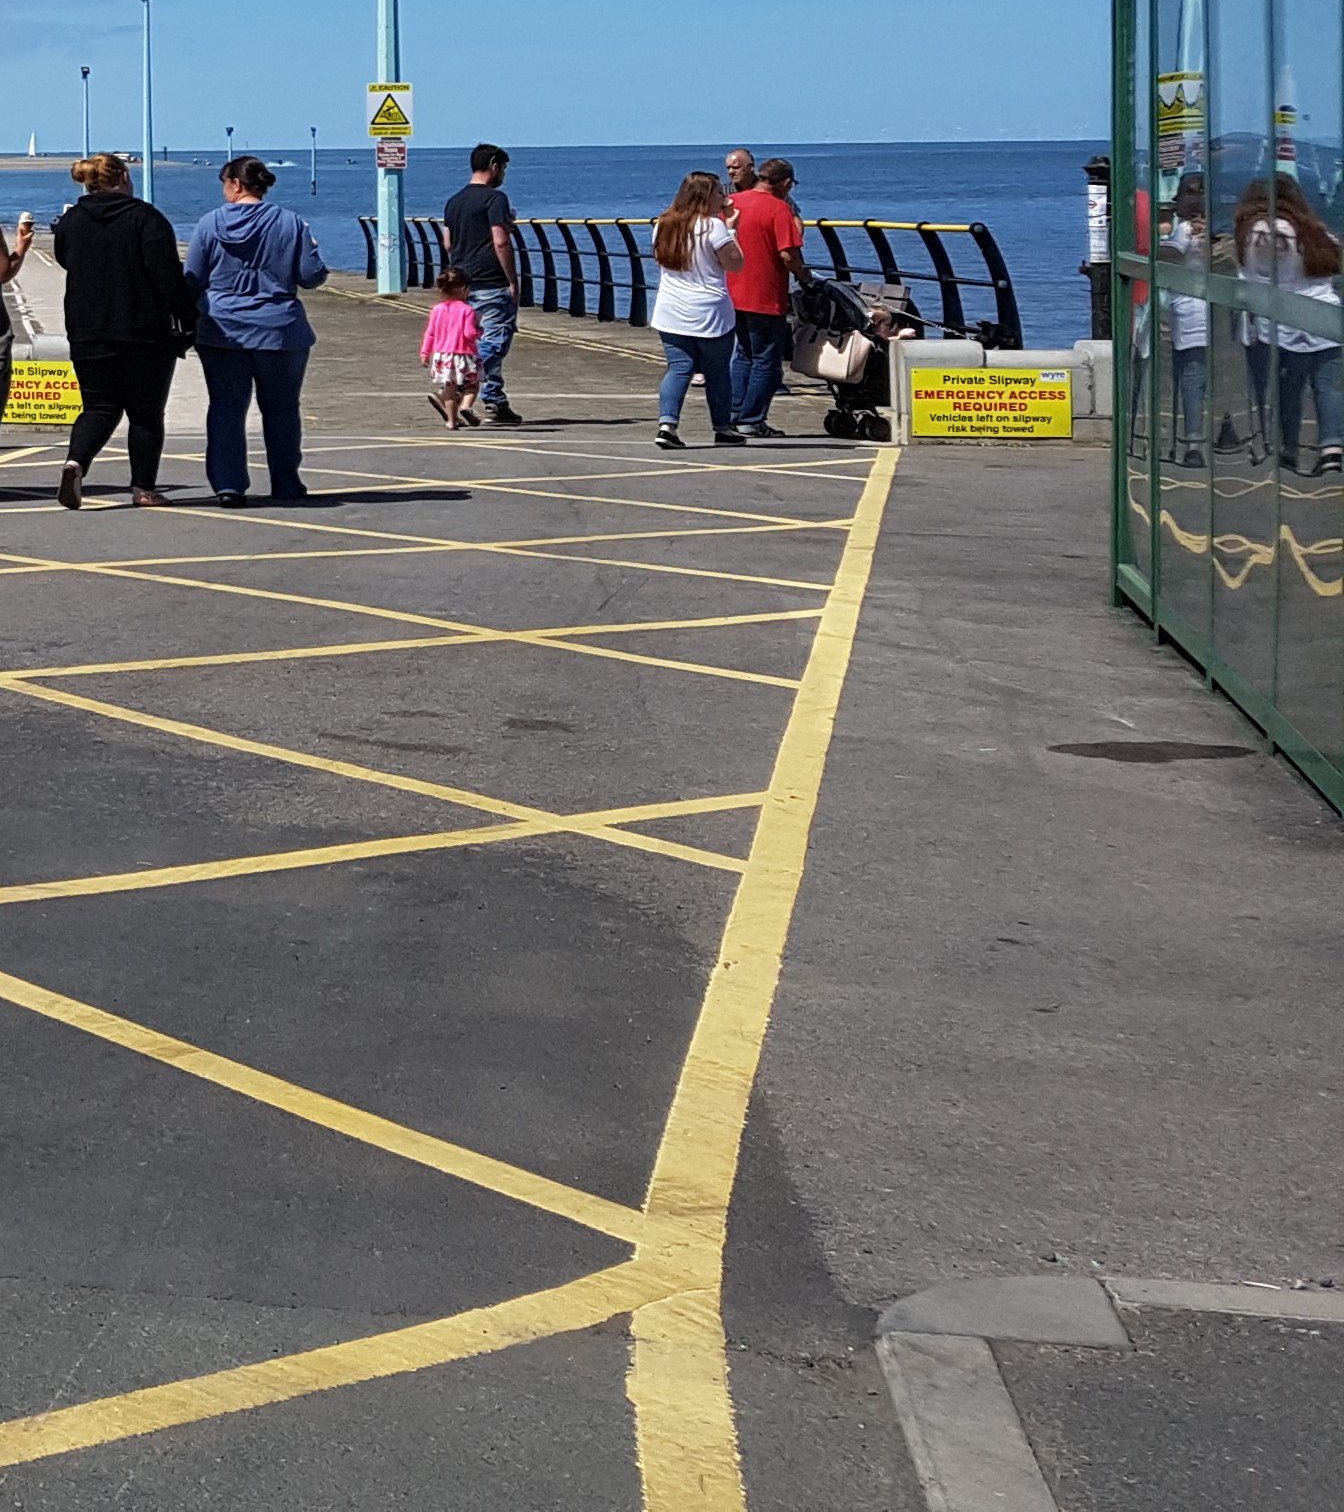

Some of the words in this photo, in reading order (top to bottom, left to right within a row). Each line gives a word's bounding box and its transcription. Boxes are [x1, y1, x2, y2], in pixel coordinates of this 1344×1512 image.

[27, 367, 69, 378] Slipway
[943, 375, 985, 385] Private
[989, 375, 1037, 388] Slipway
[914, 390, 1005, 399] EMERGENCY
[1009, 390, 1066, 400] ACCESS
[48, 402, 82, 411] slipway
[952, 402, 1028, 412] REQUIRED
[12, 411, 36, 420] being
[929, 413, 973, 422] Vehicles
[977, 414, 993, 422] left
[1013, 414, 1052, 424] slipway
[970, 425, 999, 434] being
[1002, 425, 1034, 433] towed
